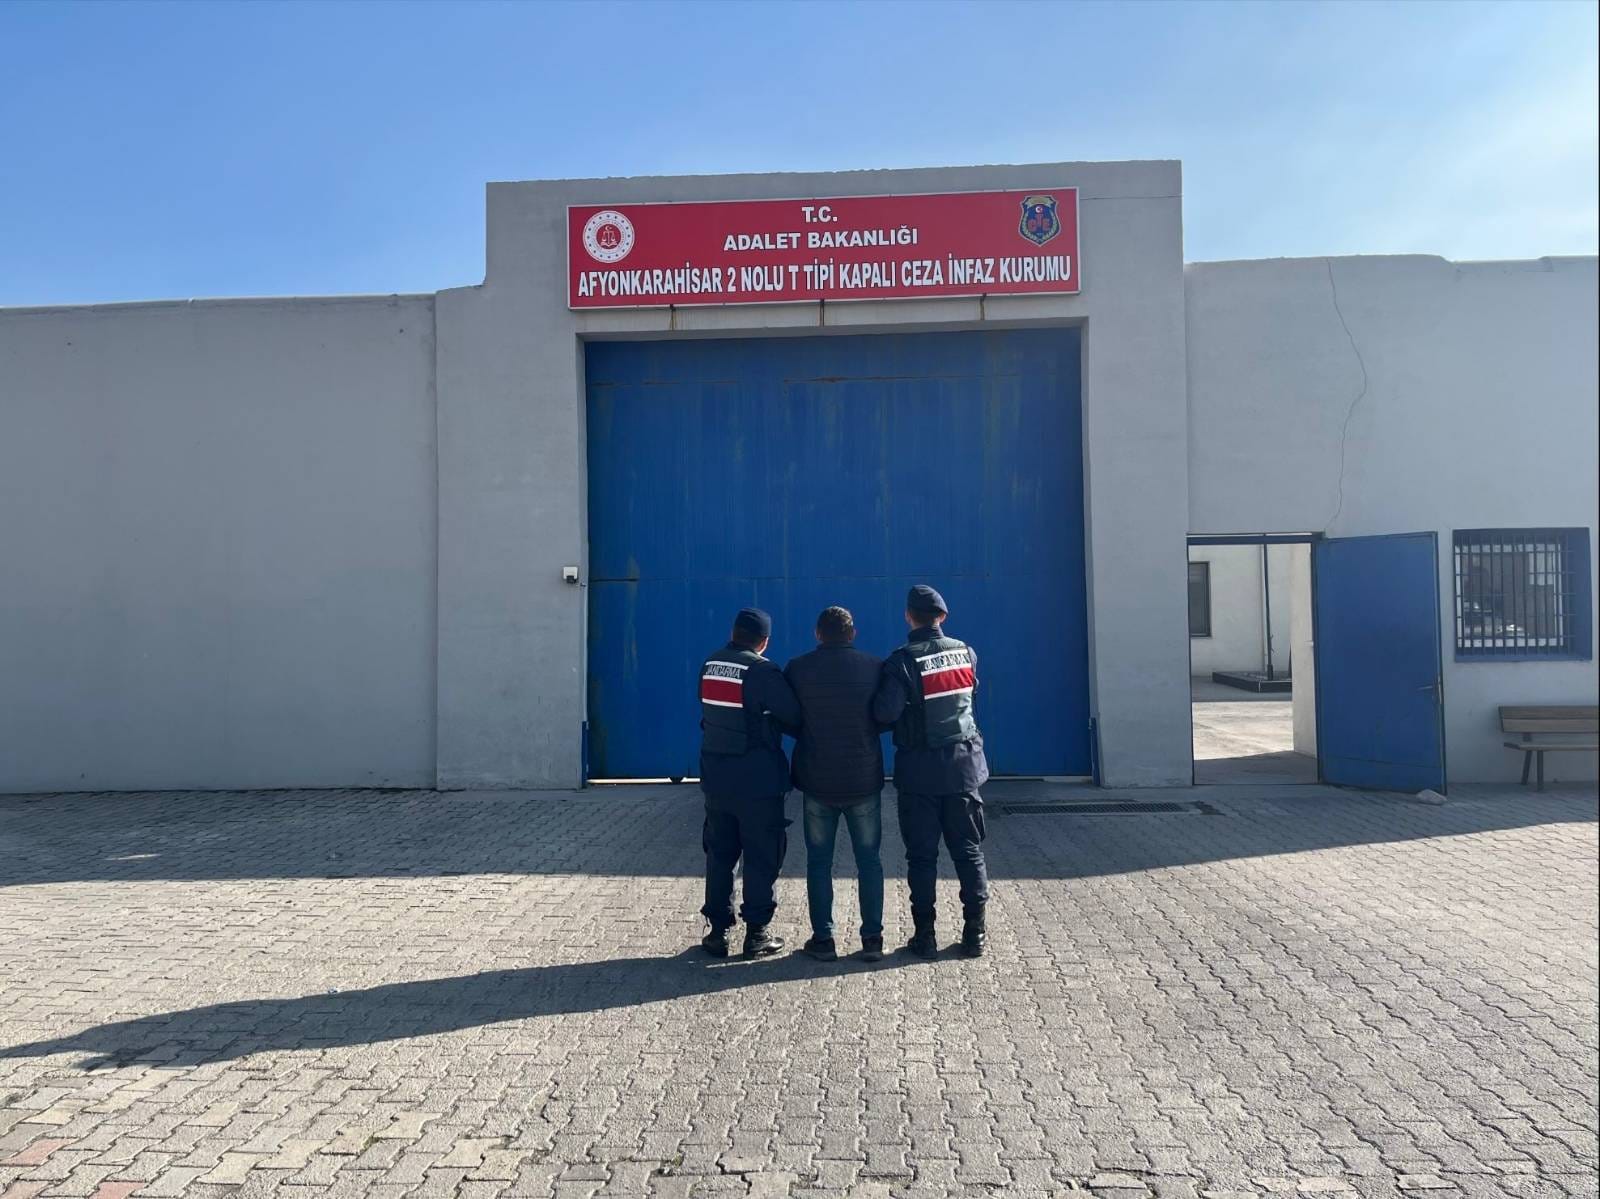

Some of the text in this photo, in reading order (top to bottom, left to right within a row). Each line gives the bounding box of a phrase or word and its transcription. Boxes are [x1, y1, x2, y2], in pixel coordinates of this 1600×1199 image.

[802, 205, 838, 223] T.C.
[724, 225, 918, 251] ADALET BAKANLIĞI
[578, 253, 1071, 297] AFYONKARAHİSAR 2 NOLU T TİPİ KAPALI CEZA İNFAZ KURUMU
